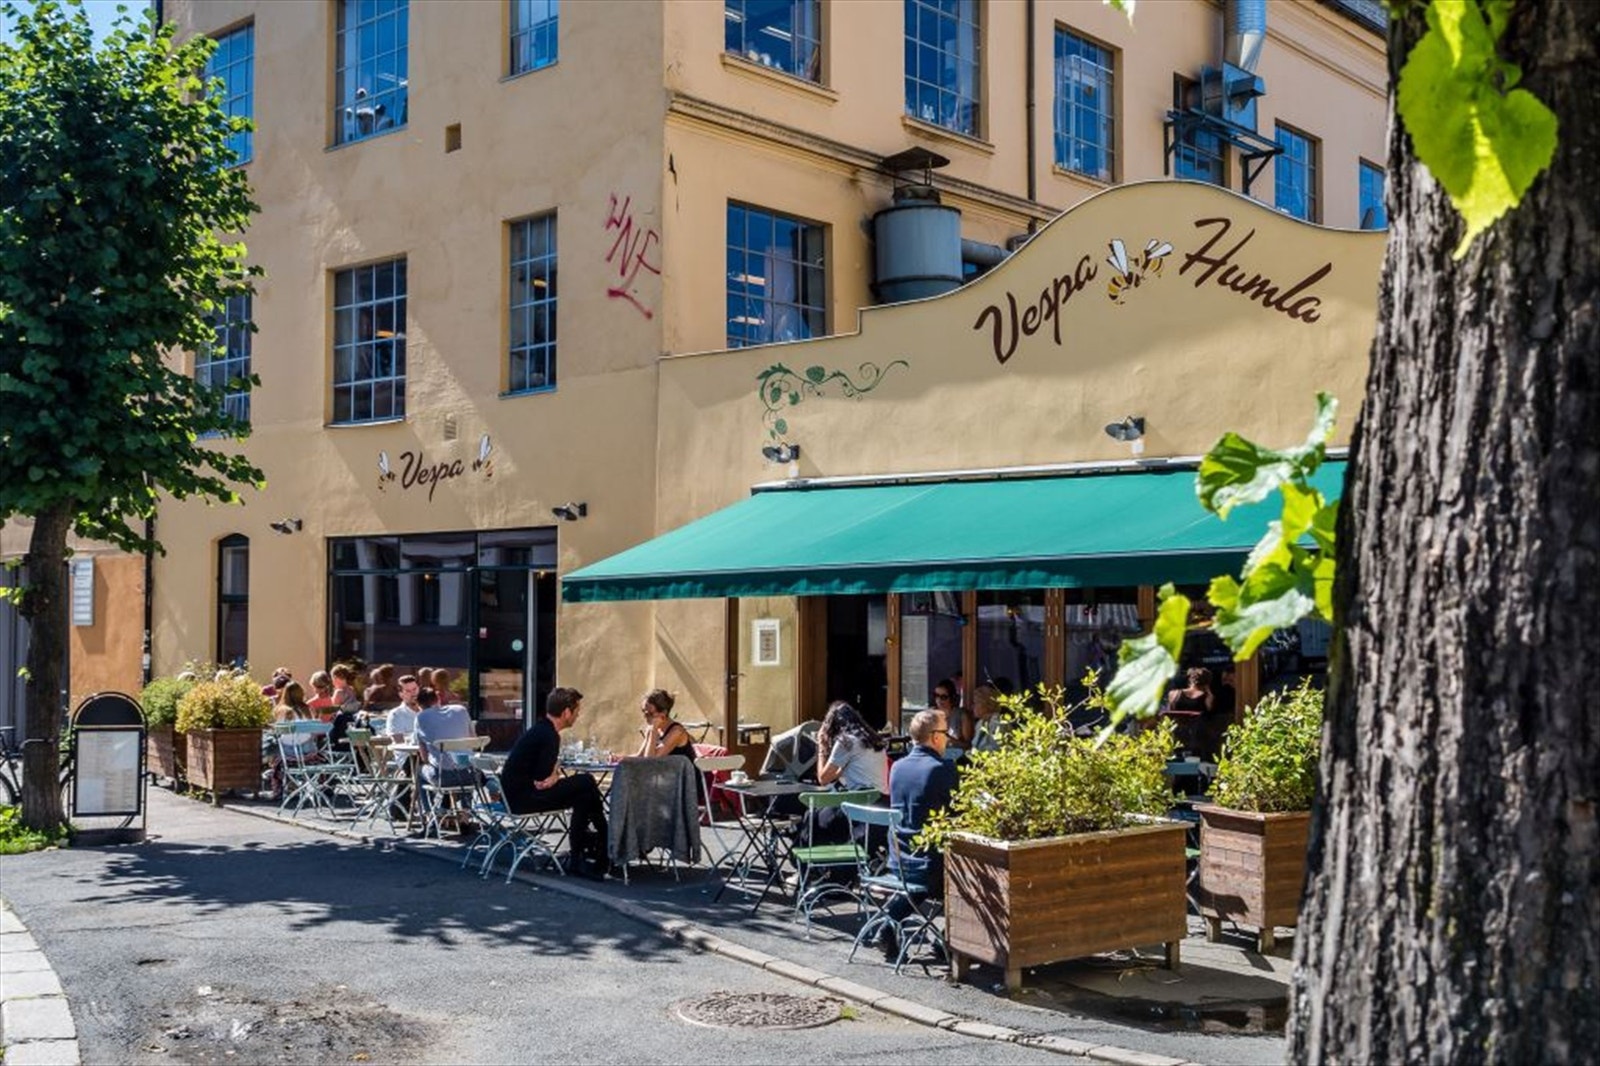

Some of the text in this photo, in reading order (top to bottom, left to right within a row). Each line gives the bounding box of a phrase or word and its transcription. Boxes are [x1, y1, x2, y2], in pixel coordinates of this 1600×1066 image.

[974, 217, 1333, 364] Vespa Humla
[400, 451, 465, 502] Vespa
